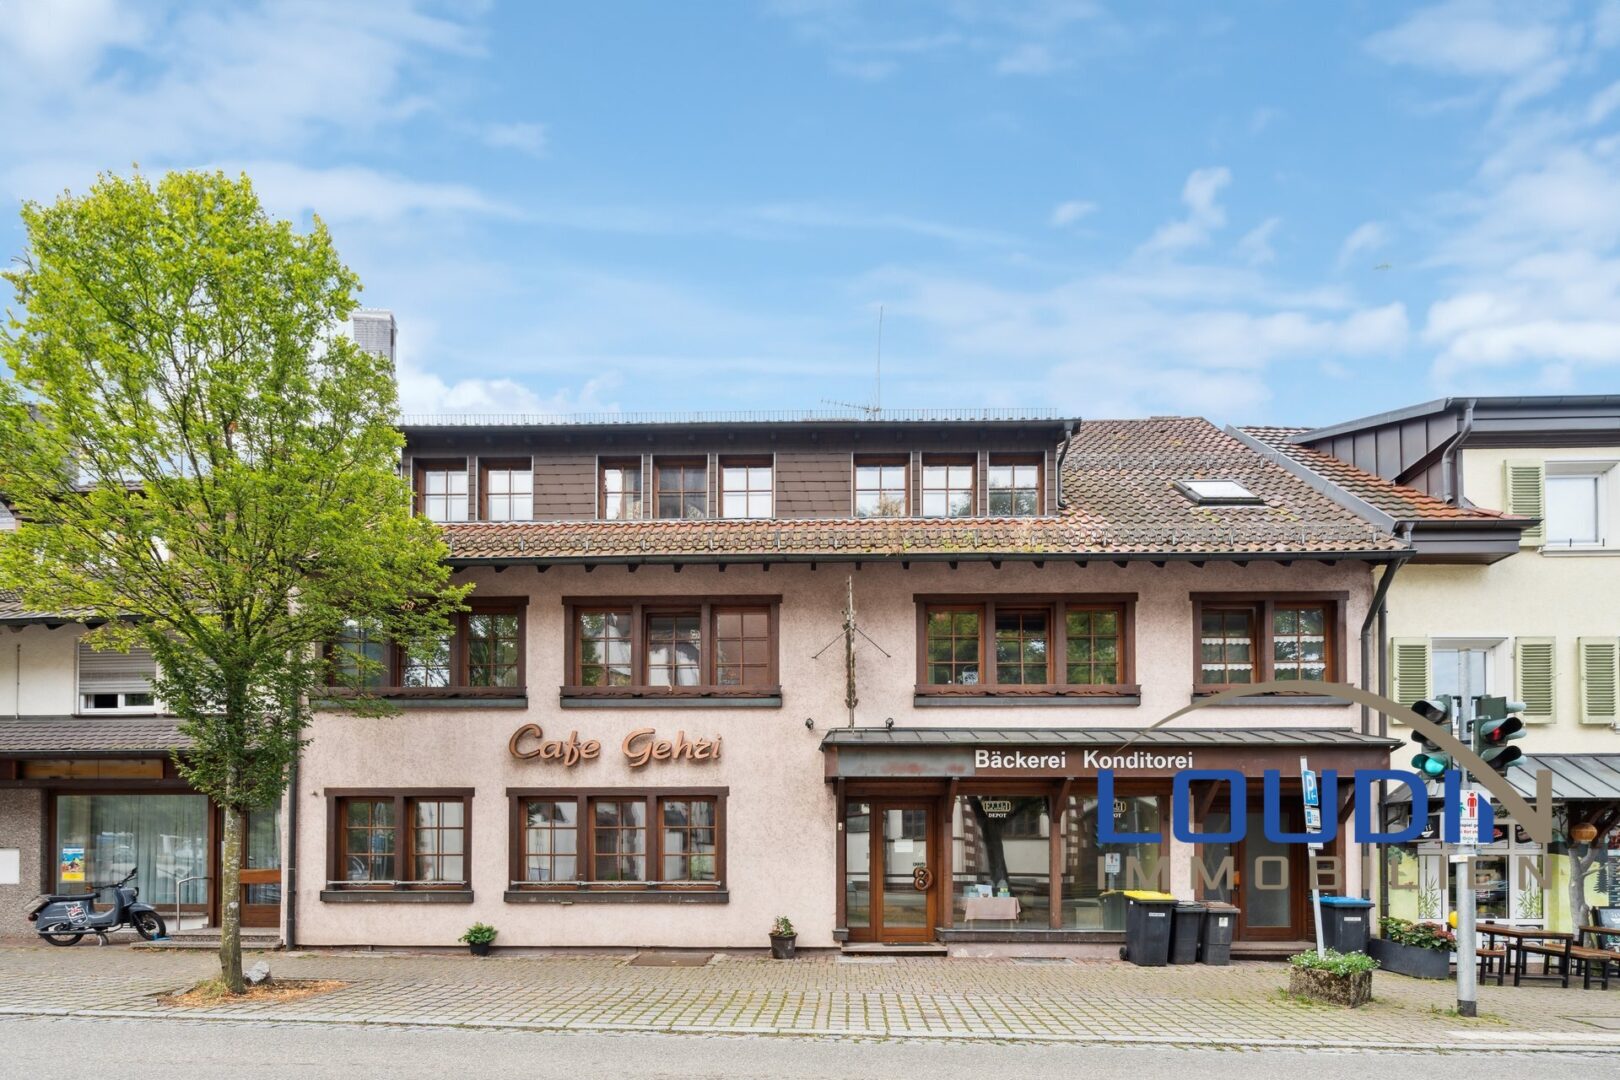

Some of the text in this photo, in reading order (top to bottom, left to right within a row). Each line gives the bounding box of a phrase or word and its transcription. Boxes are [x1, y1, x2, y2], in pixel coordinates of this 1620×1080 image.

[509, 723, 601, 767] Cafe
[975, 749, 1194, 769] Bäckerei Konditorei
